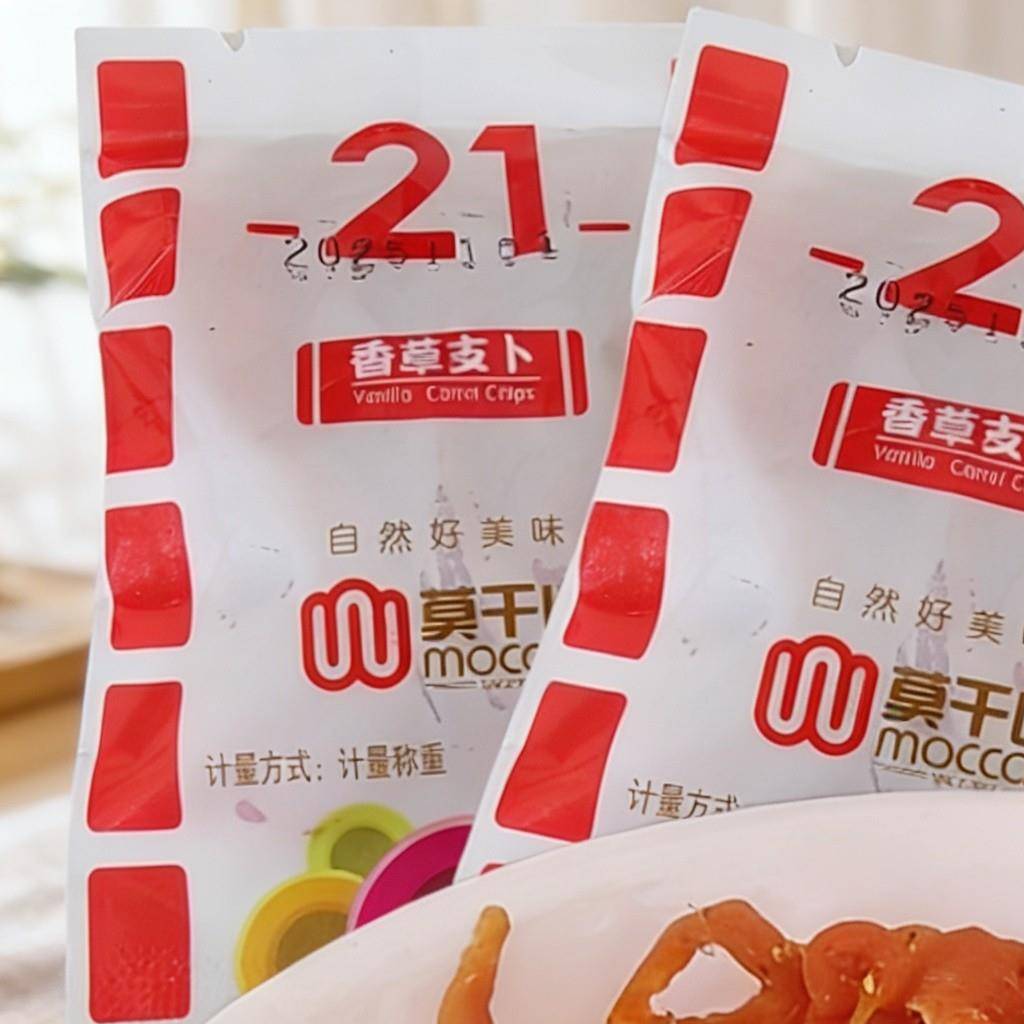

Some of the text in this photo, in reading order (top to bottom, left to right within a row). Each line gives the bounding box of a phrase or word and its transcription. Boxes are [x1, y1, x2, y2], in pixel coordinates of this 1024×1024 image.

[330, 514, 565, 555] 自然好美味
[420, 584, 558, 642] 莫干
[423, 643, 540, 679] mocc
